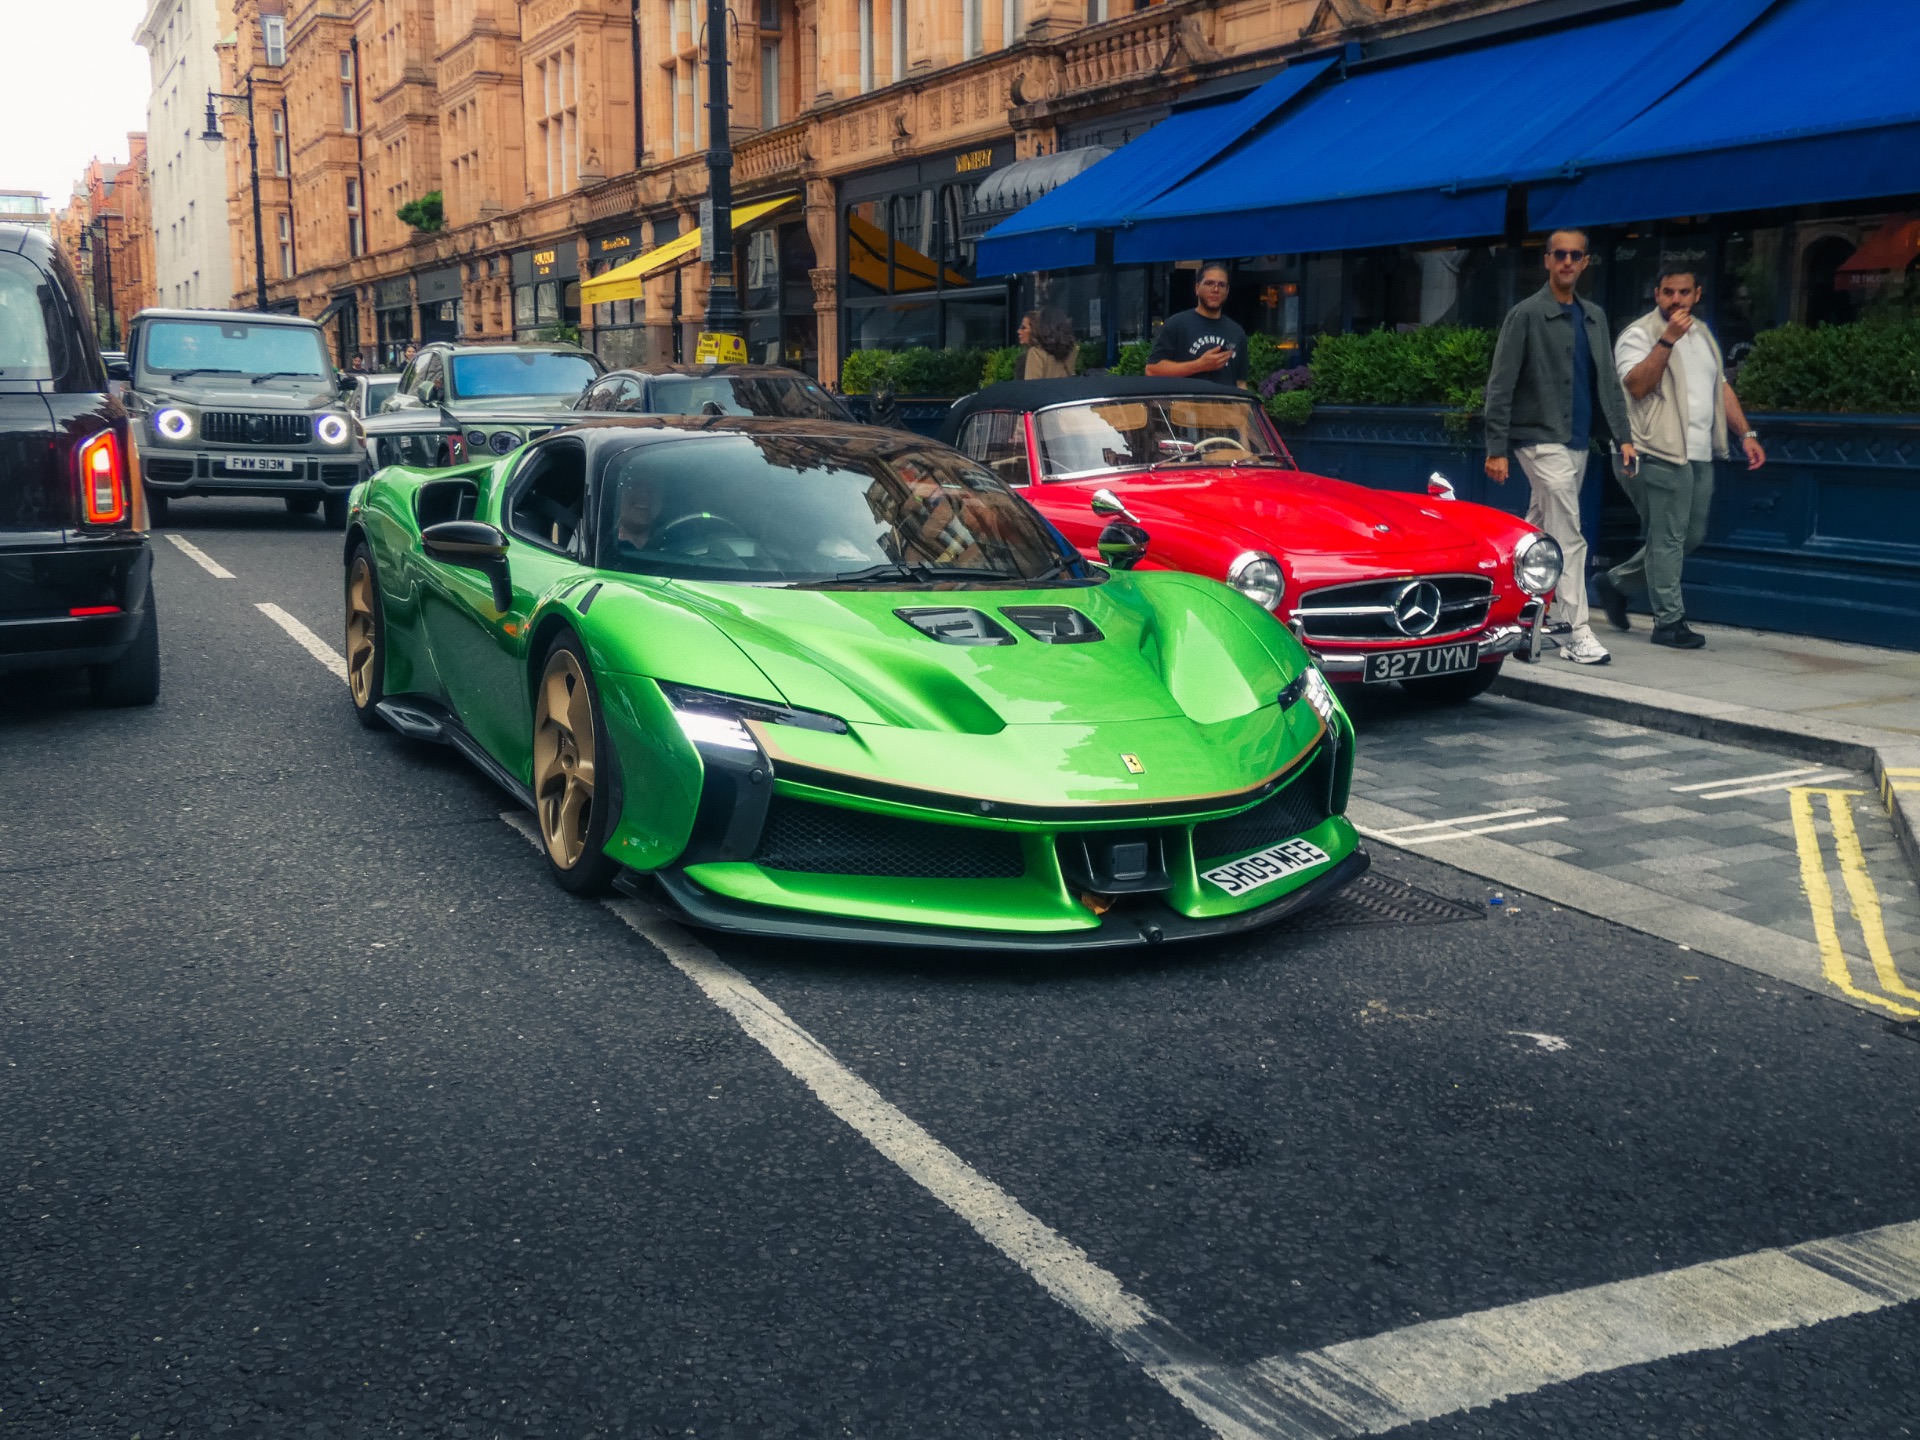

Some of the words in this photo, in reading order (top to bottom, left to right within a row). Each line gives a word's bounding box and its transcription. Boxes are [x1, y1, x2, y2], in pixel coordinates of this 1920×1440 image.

[1189, 335, 1236, 358] ESSENTI
[258, 458, 285, 470] 913M
[1374, 651, 1422, 679] 327
[1426, 645, 1470, 673] UYN
[1207, 856, 1283, 892] SH09
[1264, 840, 1326, 870] MEE
